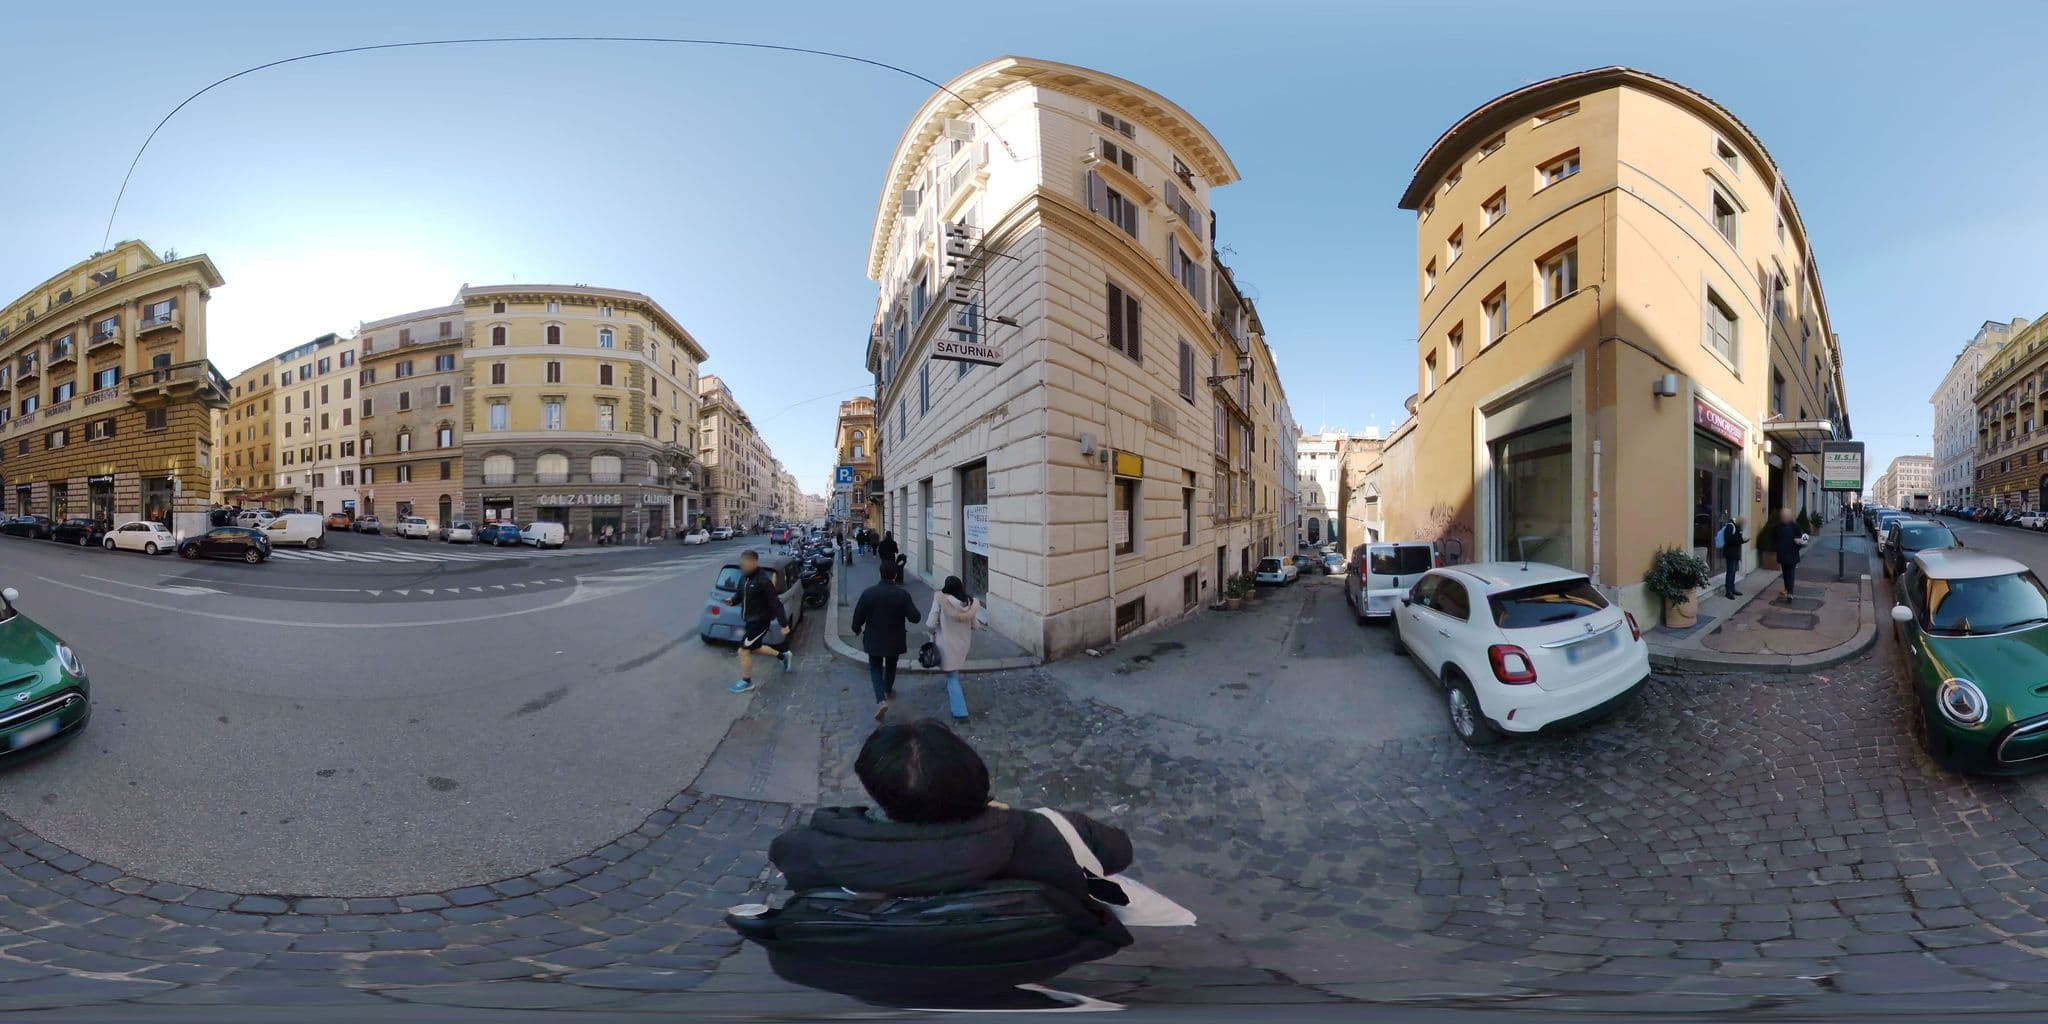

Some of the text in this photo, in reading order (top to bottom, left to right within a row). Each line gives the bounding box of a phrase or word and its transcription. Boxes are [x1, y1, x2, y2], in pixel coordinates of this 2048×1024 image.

[945, 223, 972, 333] HOTEL
[937, 342, 994, 359] SATURNIA
[839, 469, 849, 481] P
[540, 494, 621, 505] CALZATURE
